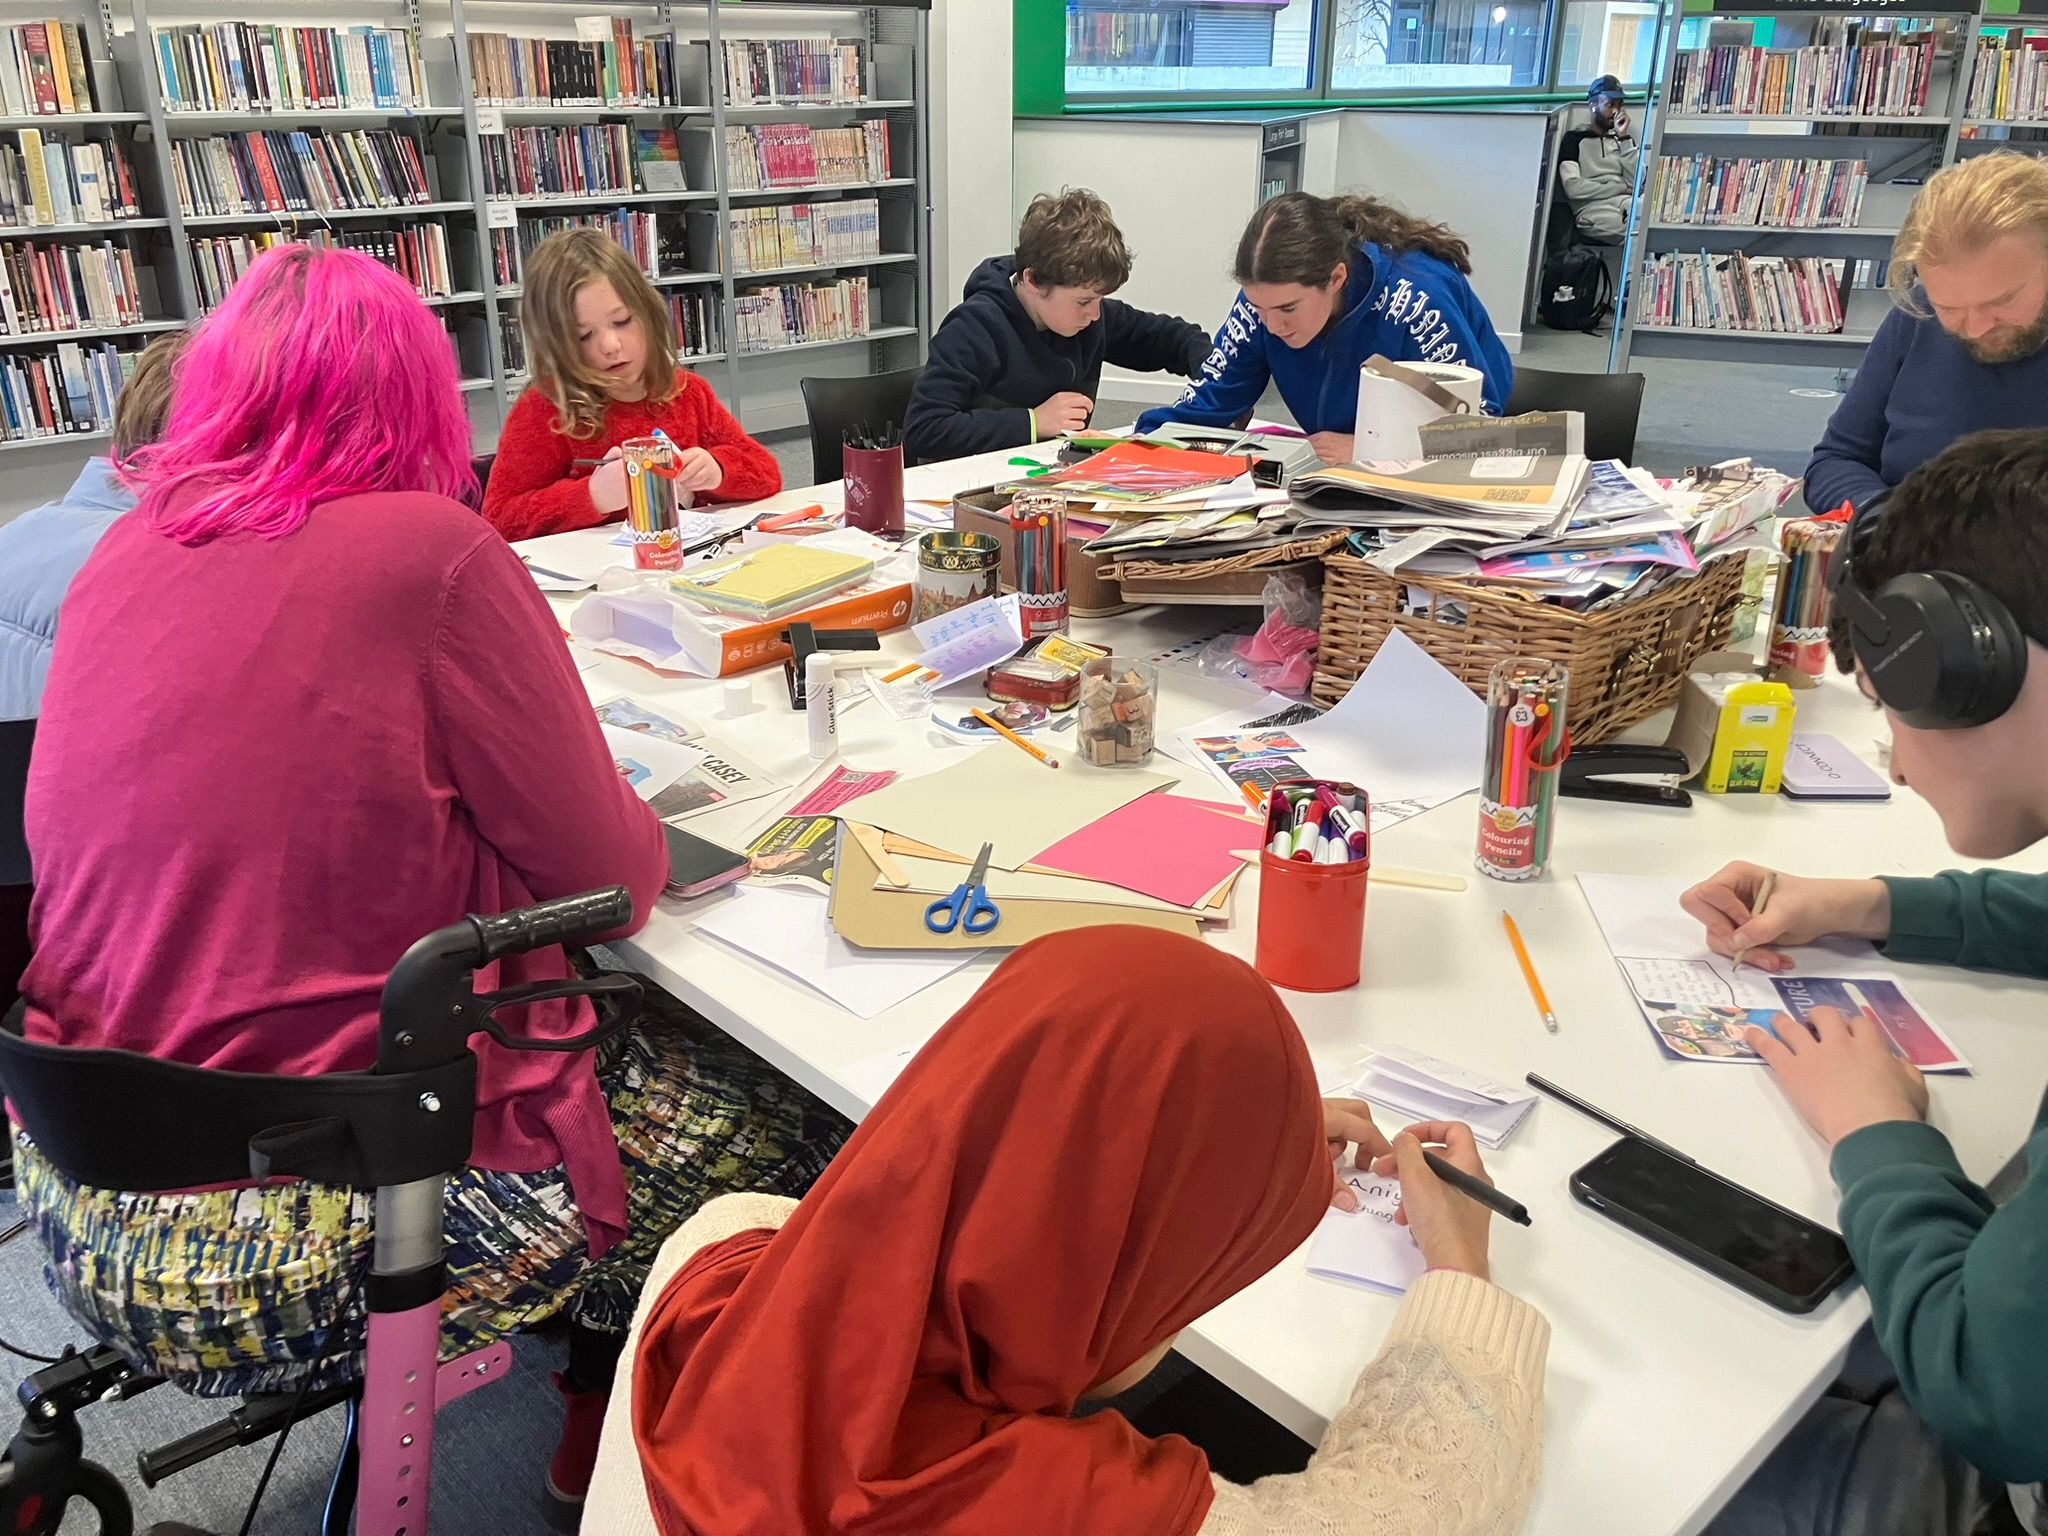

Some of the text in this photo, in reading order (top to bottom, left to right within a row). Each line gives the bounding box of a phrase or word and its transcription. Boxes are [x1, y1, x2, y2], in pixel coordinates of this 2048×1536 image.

[851, 612, 890, 627] Premium
[826, 685, 837, 735] Glue Stick
[702, 759, 751, 783] CASEY
[1481, 828, 1530, 846] Colouring
[1485, 841, 1523, 856] Pencils
